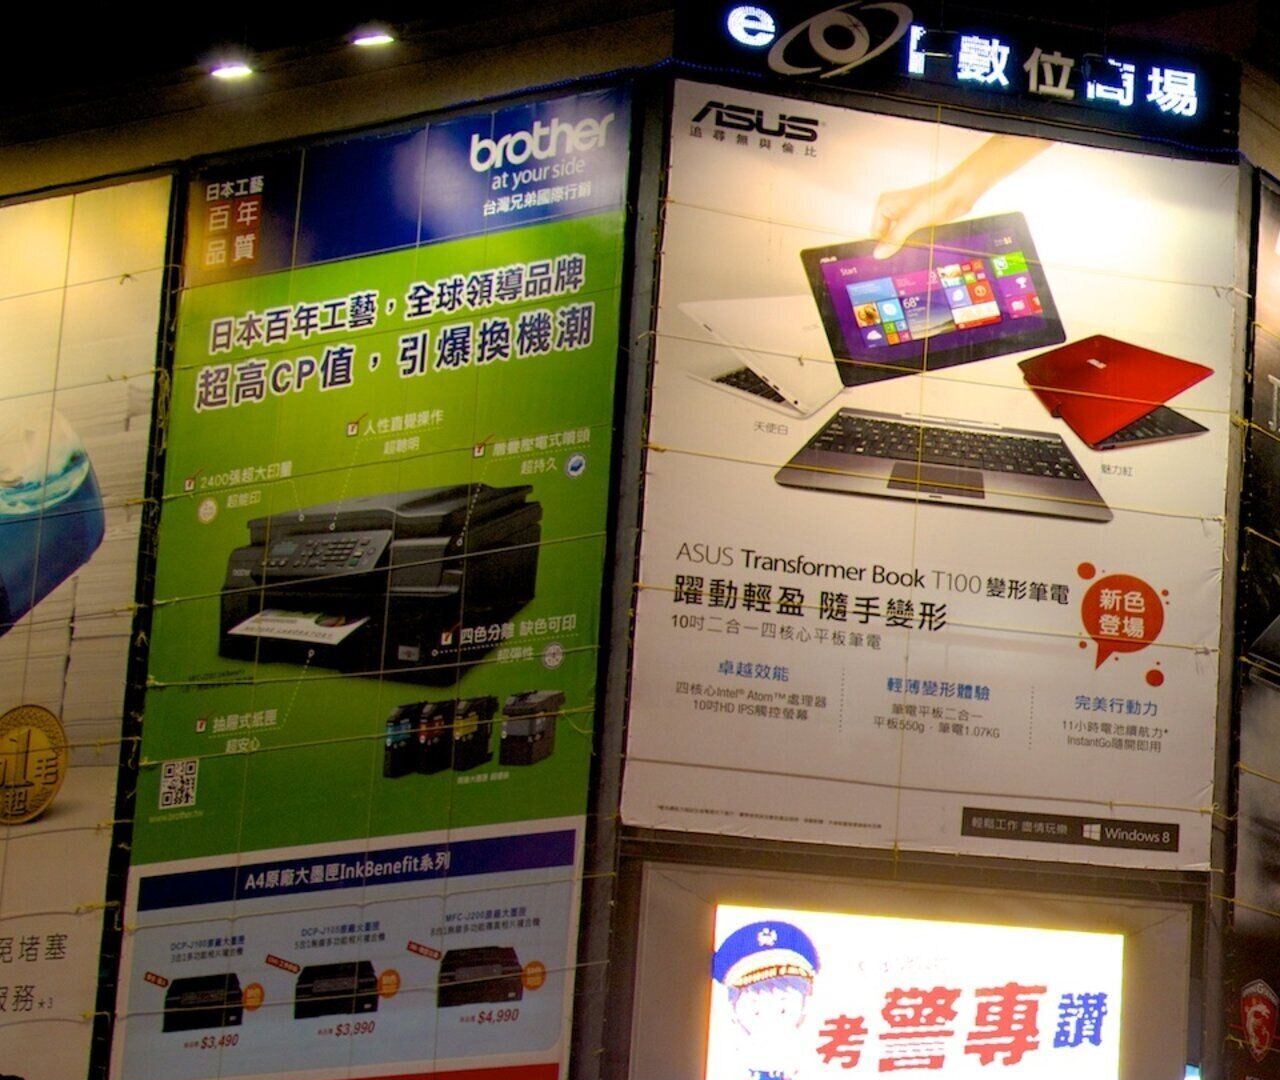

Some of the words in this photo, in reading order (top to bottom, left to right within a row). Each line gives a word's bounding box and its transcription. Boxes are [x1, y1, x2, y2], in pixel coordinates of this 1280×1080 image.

[691, 100, 820, 143] ASUS
[470, 113, 614, 173] brother
[688, 125, 818, 158] 追尋無與倫比
[206, 176, 264, 201] 日本工藝
[491, 172, 510, 191] at
[514, 166, 549, 194] your
[551, 157, 586, 181] side
[677, 542, 735, 567] ASUS
[742, 547, 866, 583] Transformer
[873, 563, 926, 589] Book
[931, 569, 982, 594] T100
[985, 575, 1070, 606] 變形筆電
[673, 573, 806, 619] 躍動輕盈
[820, 589, 948, 633] 隨手變形
[1098, 588, 1146, 614] 新色
[1098, 614, 1146, 640] 登場
[717, 659, 790, 683] 卓越效能
[886, 676, 991, 702] 輕薄變形體驗
[1074, 693, 1159, 718] 完美行動力
[1104, 824, 1159, 844] Windows
[1161, 829, 1171, 844] 8
